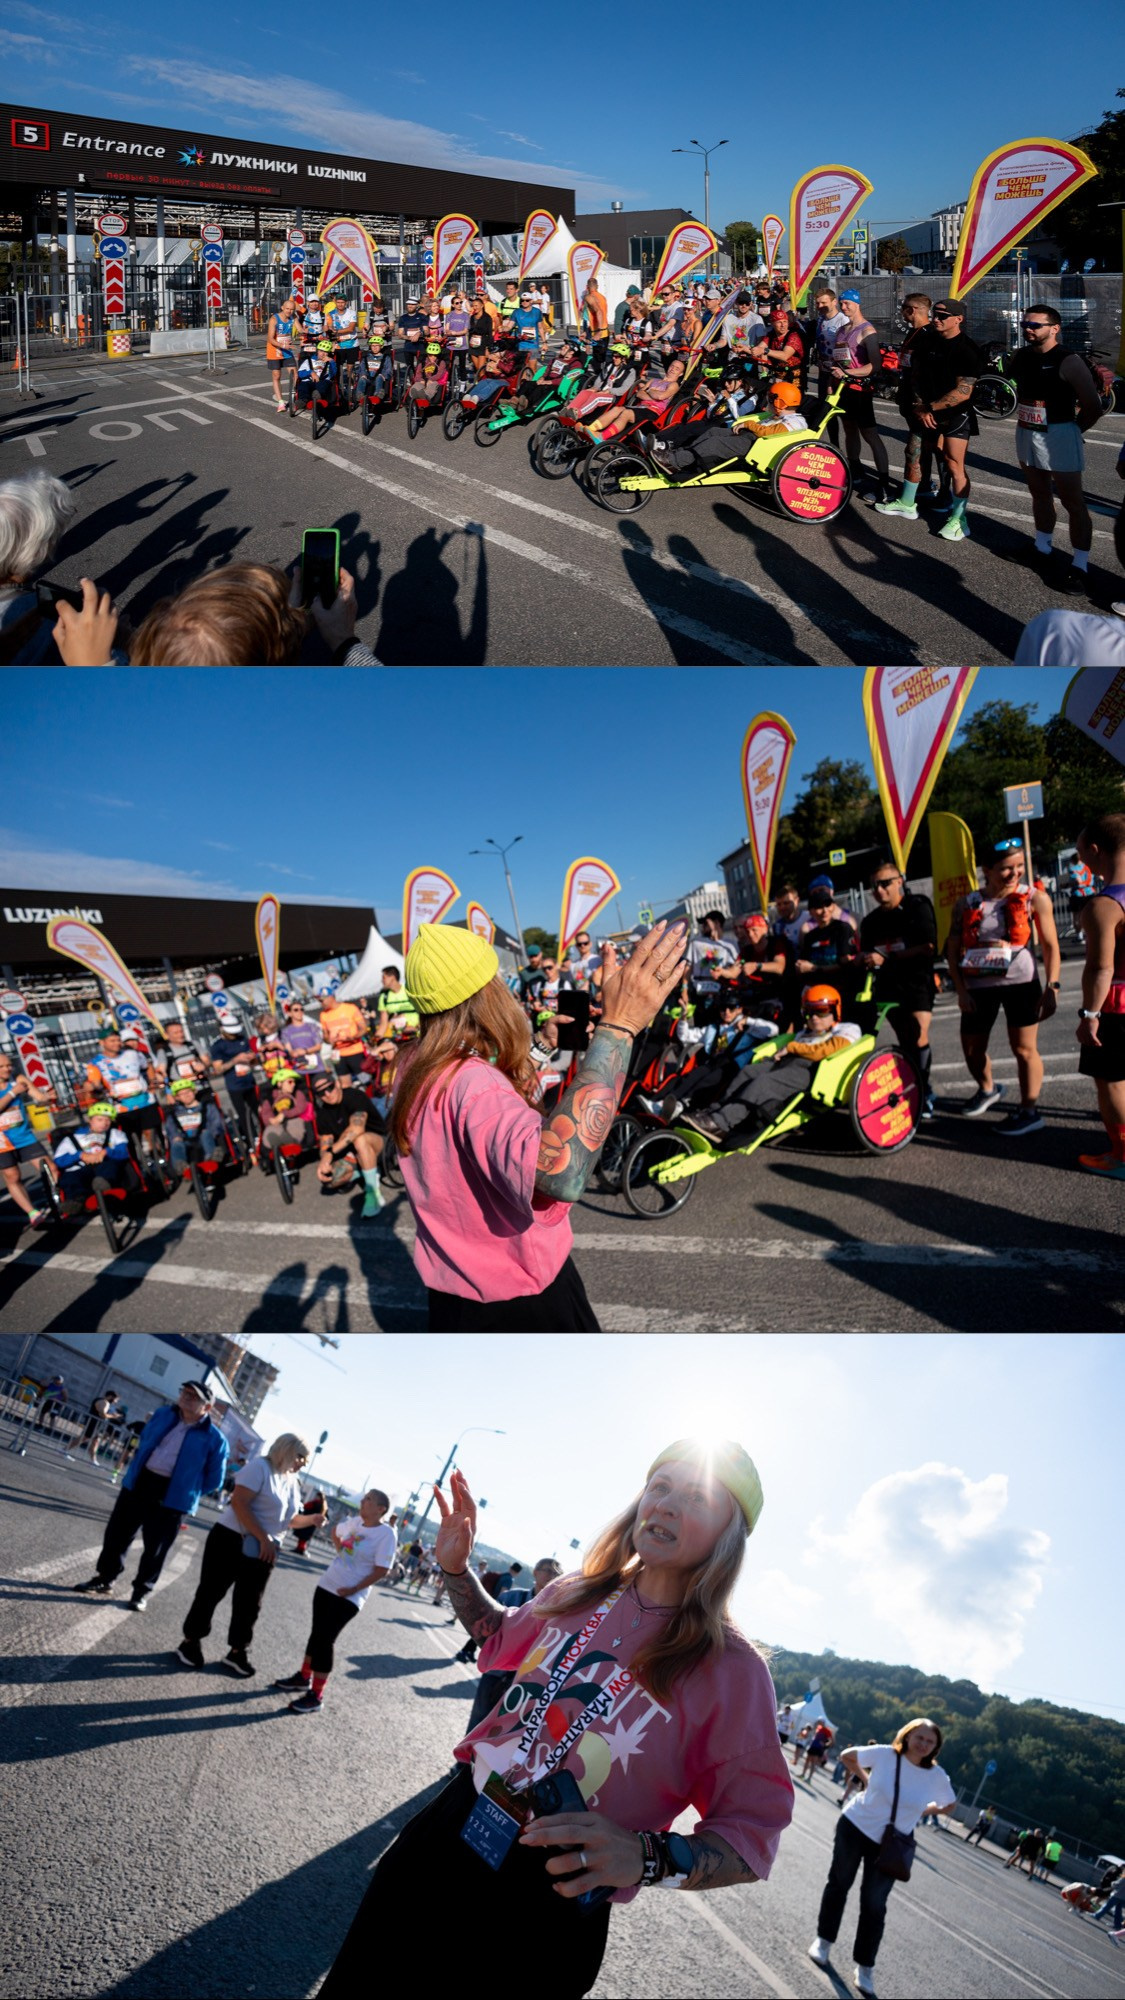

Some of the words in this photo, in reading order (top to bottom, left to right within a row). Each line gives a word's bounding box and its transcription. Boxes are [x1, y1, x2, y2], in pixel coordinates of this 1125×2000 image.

[23, 126, 38, 143] 5
[62, 131, 166, 158] Entrance
[210, 152, 298, 175] ЛУЖНИКИ
[106, 171, 144, 181] первые
[147, 175, 160, 183] 30
[162, 177, 190, 187] минут
[228, 183, 240, 191] без
[242, 185, 272, 194] оплаты
[307, 165, 367, 183] LUZHNIKI
[1000, 175, 1045, 186] БОЛЬШЕ
[995, 189, 1043, 200] МОЖЕШЬ
[1009, 184, 1031, 192] ЧЕМ
[805, 220, 830, 229] 5:30
[800, 451, 836, 465] БОЛЬШЕ
[808, 461, 825, 470] ЧЕМ
[795, 465, 832, 479] МОЖЕШЬ
[796, 487, 832, 500] МОЖЕШЬ
[802, 496, 819, 505] ЧЕМ
[908, 676, 932, 696] ЧЕМ
[897, 677, 950, 716] МОЖЕШЬ
[518, 1669, 567, 1753] МАРАФОН
[559, 1612, 607, 1671] МОСКВА
[545, 1691, 613, 1770] MARATHON
[484, 1803, 509, 1827] STAFF
